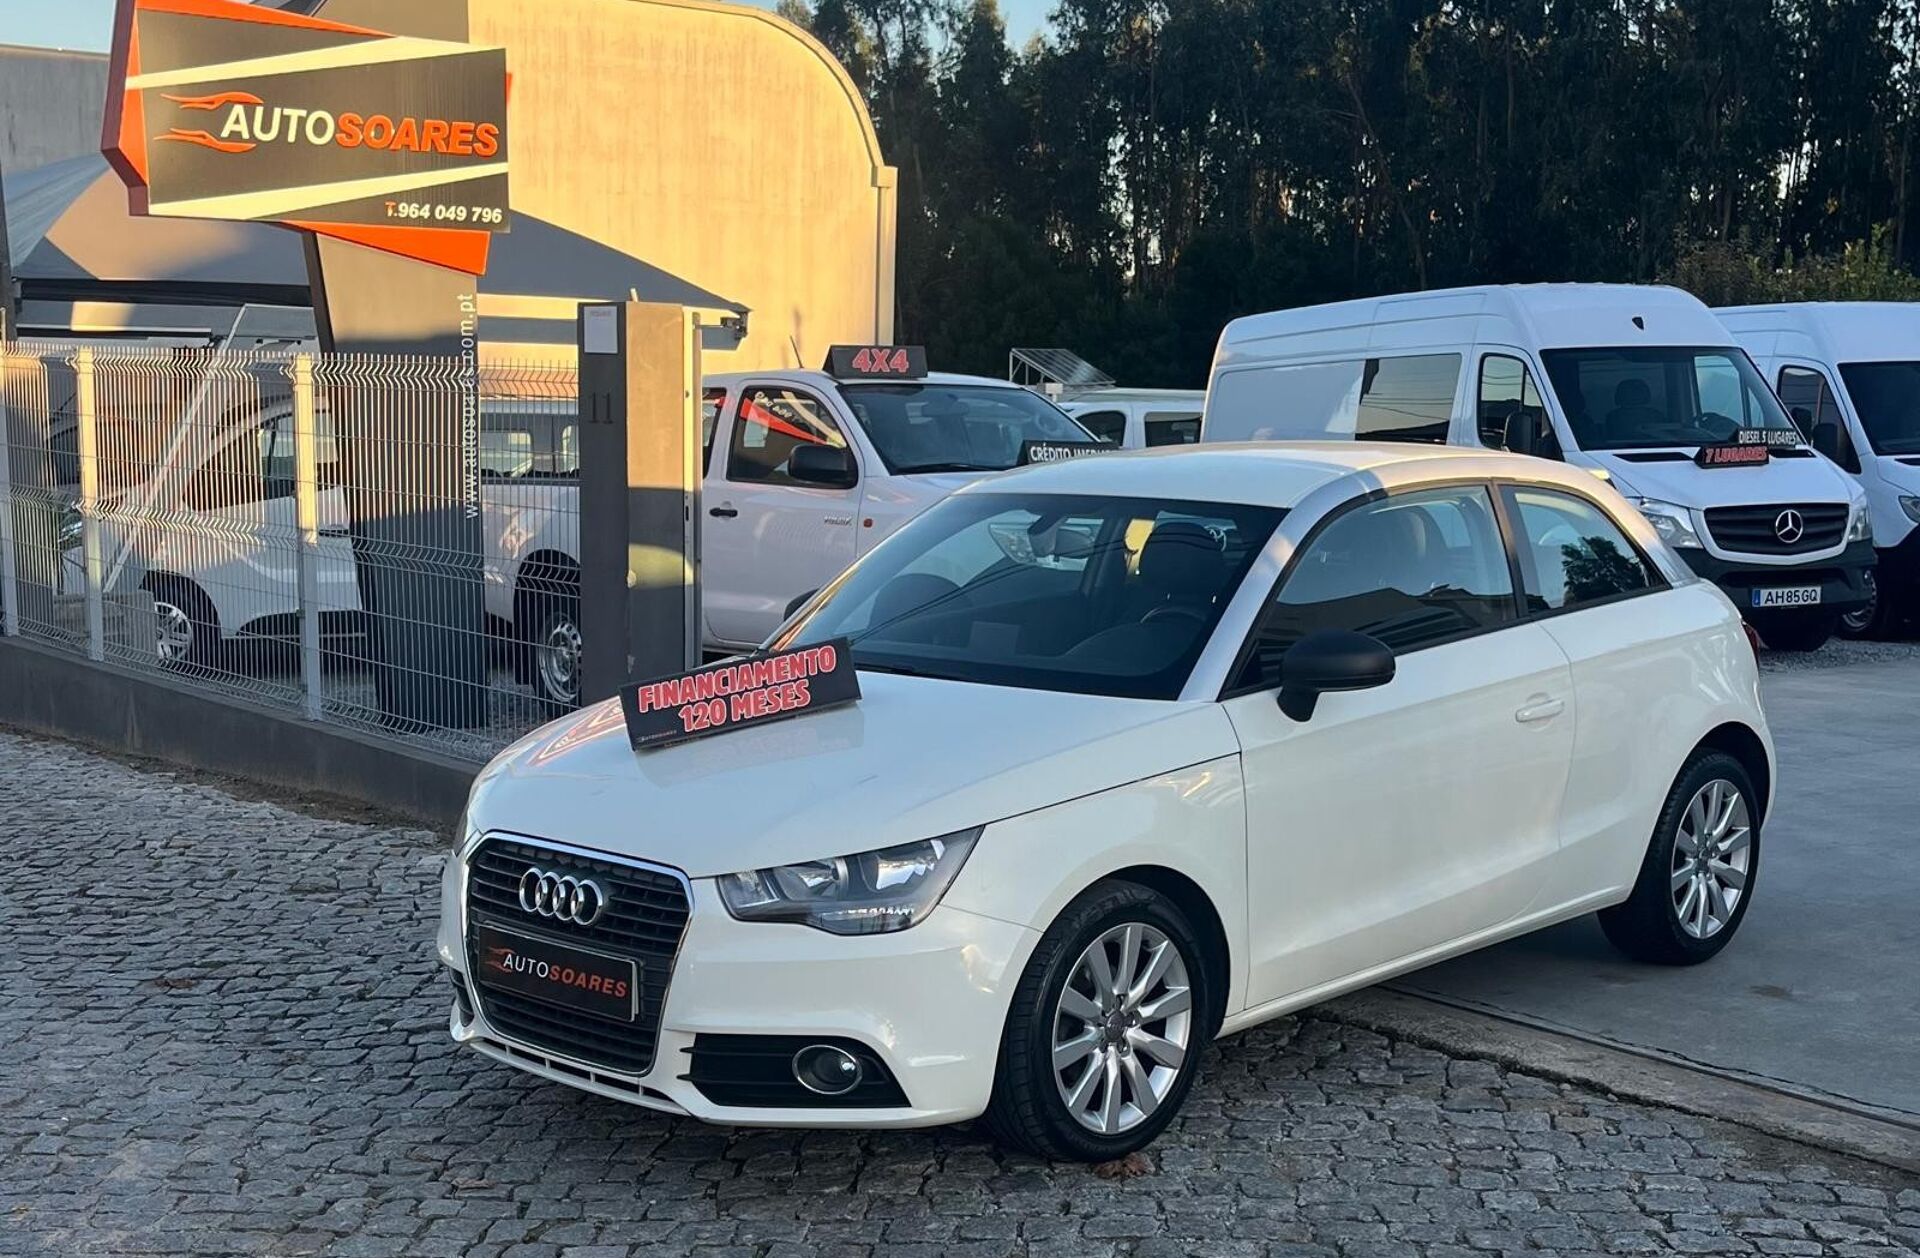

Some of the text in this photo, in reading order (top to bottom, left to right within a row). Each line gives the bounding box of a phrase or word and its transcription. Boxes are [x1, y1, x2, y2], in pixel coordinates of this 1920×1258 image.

[220, 103, 500, 157] AUTOSOARES
[385, 201, 503, 224] T.964 049 796
[852, 348, 909, 373] 4X4
[457, 294, 479, 519] www.autosoaescom.pt
[587, 391, 614, 424] 11
[1030, 442, 1071, 461] CRÉDITO
[1738, 430, 1797, 445] DIESEL 5 LUGARES
[1705, 446, 1768, 463] 7 LUGARES
[1764, 589, 1818, 604] AH85GQ
[637, 644, 837, 713] FINANCIAMENTO
[678, 678, 811, 733] 120 MESES
[503, 953, 628, 998] AUTOSOARES
